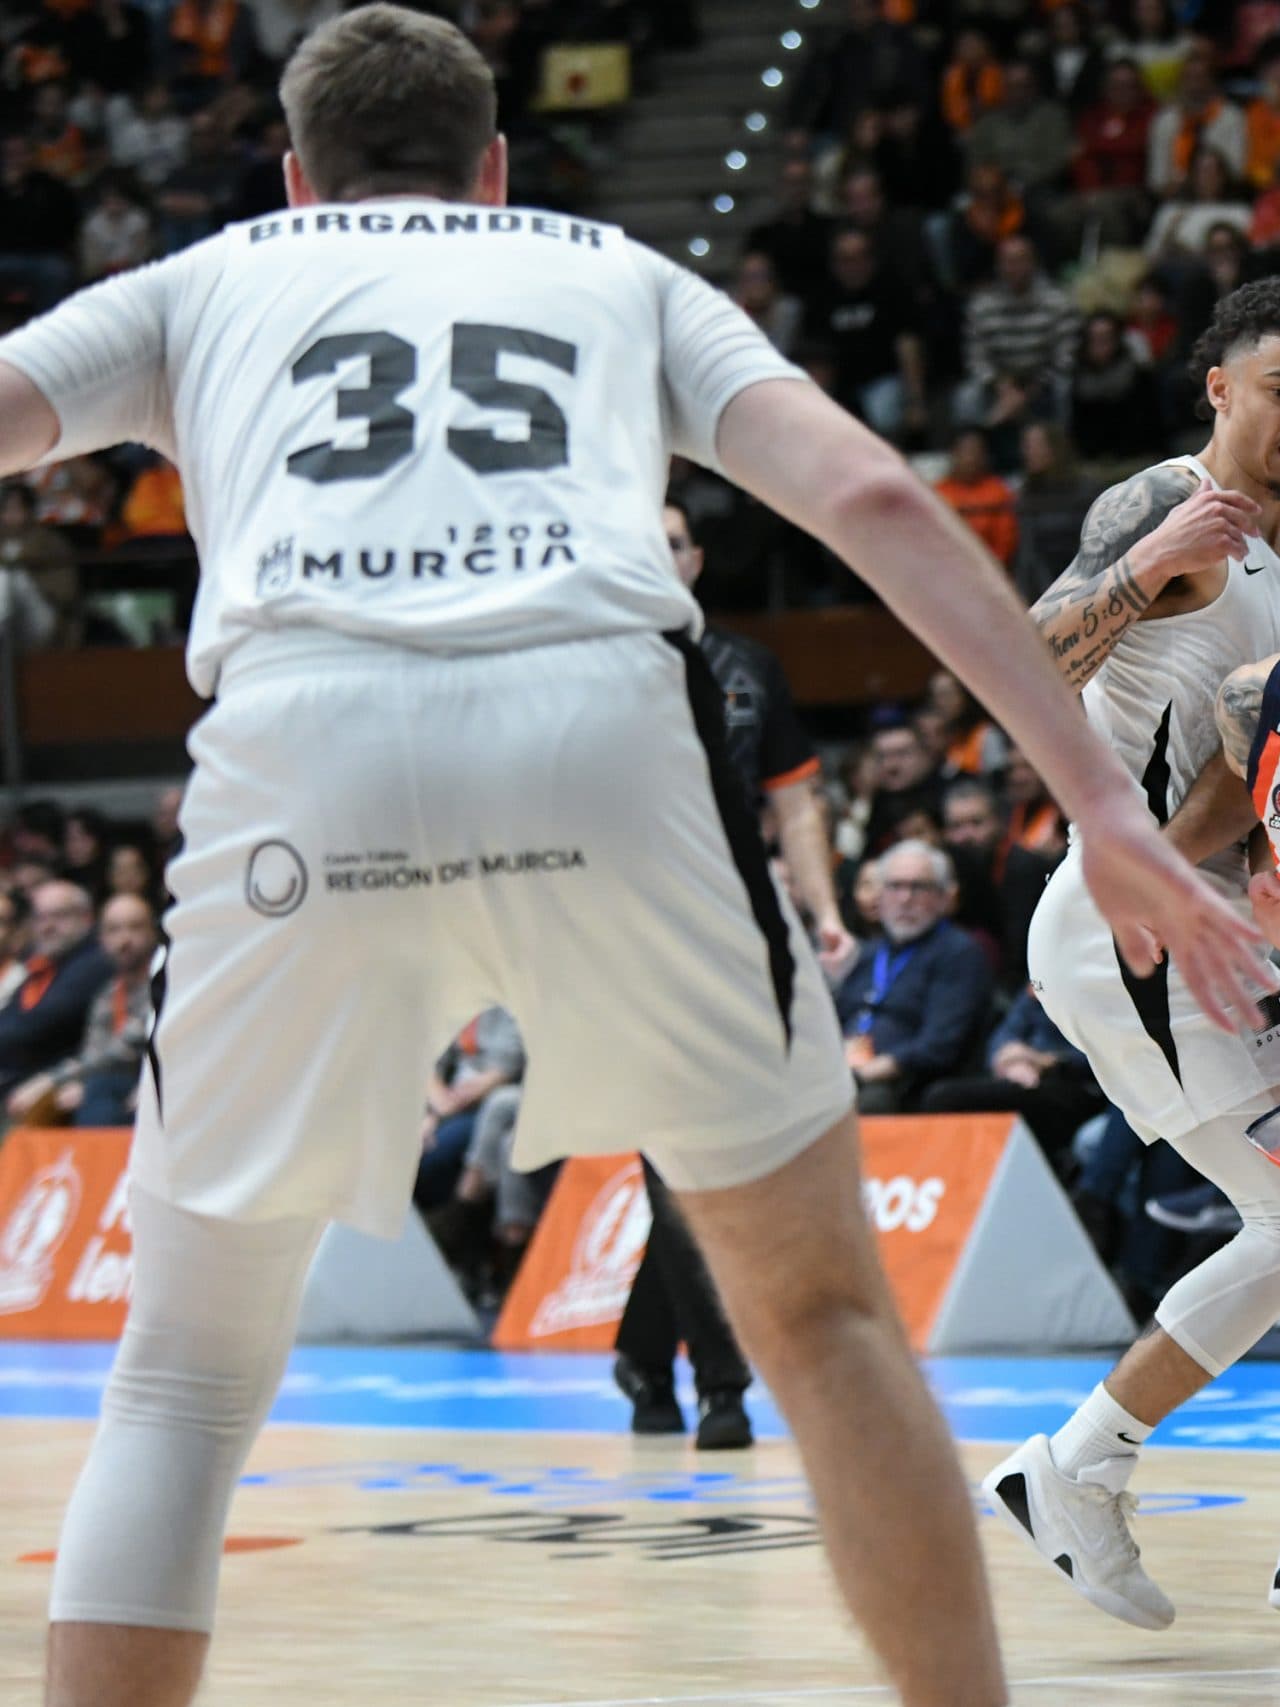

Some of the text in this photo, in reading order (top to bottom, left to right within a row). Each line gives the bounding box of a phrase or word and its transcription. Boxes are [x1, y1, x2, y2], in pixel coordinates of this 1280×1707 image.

[249, 212, 603, 249] BIRGANDER
[286, 321, 578, 486] 35
[446, 521, 570, 544] 1200
[301, 543, 577, 580] MURCIA
